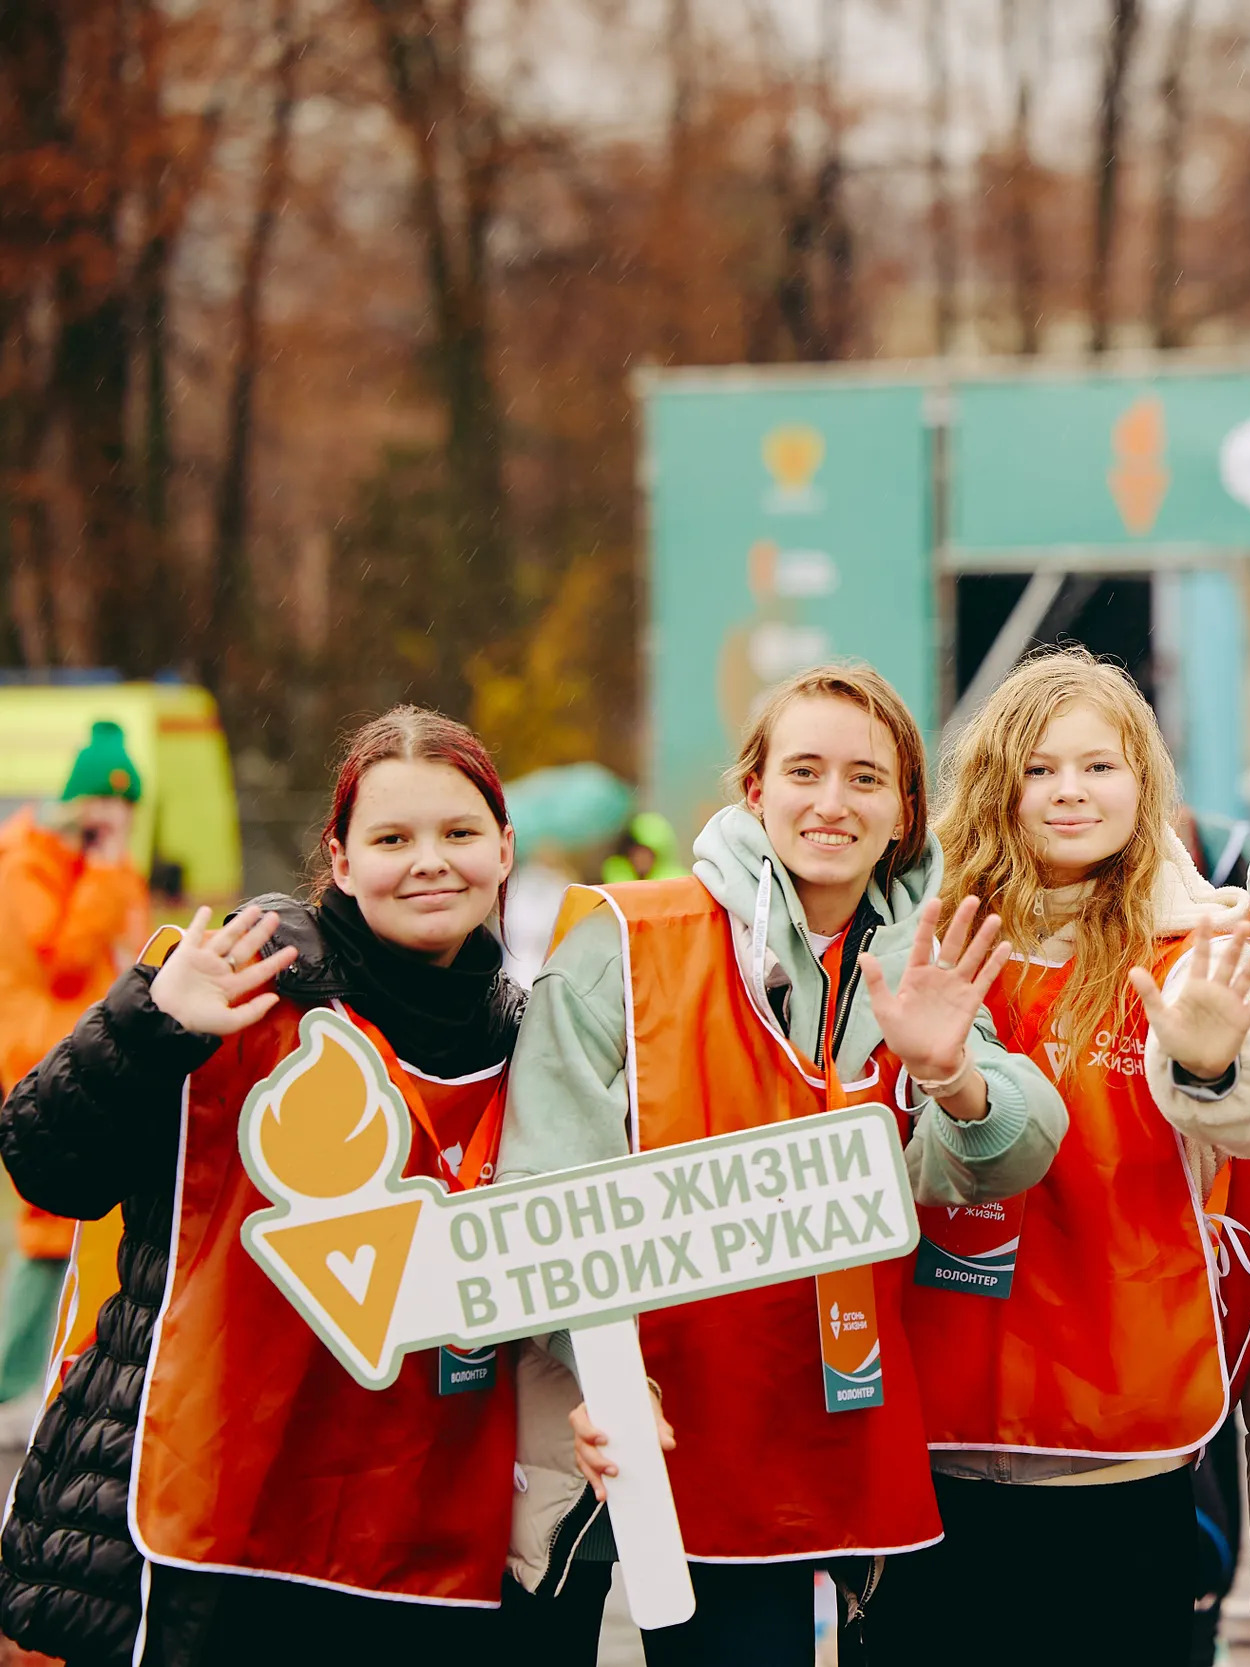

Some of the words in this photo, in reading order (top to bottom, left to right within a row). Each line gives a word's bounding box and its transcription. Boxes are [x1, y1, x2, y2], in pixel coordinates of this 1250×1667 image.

[1087, 1051, 1145, 1076] ЖИЗН
[449, 1180, 646, 1262] ОГОНЬ
[653, 1128, 872, 1220] ЖИЗНИ
[964, 1207, 1006, 1221] ЖИЗНИ
[456, 1275, 498, 1328] В
[506, 1231, 702, 1316] ТВОИХ
[710, 1189, 895, 1274] РУКАХ
[935, 1267, 998, 1287] ВОЛОНТЕР
[843, 1311, 865, 1322] ОГОНЬ
[842, 1321, 868, 1332] ЖИЗНИ
[450, 1367, 488, 1384] ВОЛОНТЕР
[836, 1386, 875, 1402] ВОЛОНТЕР
